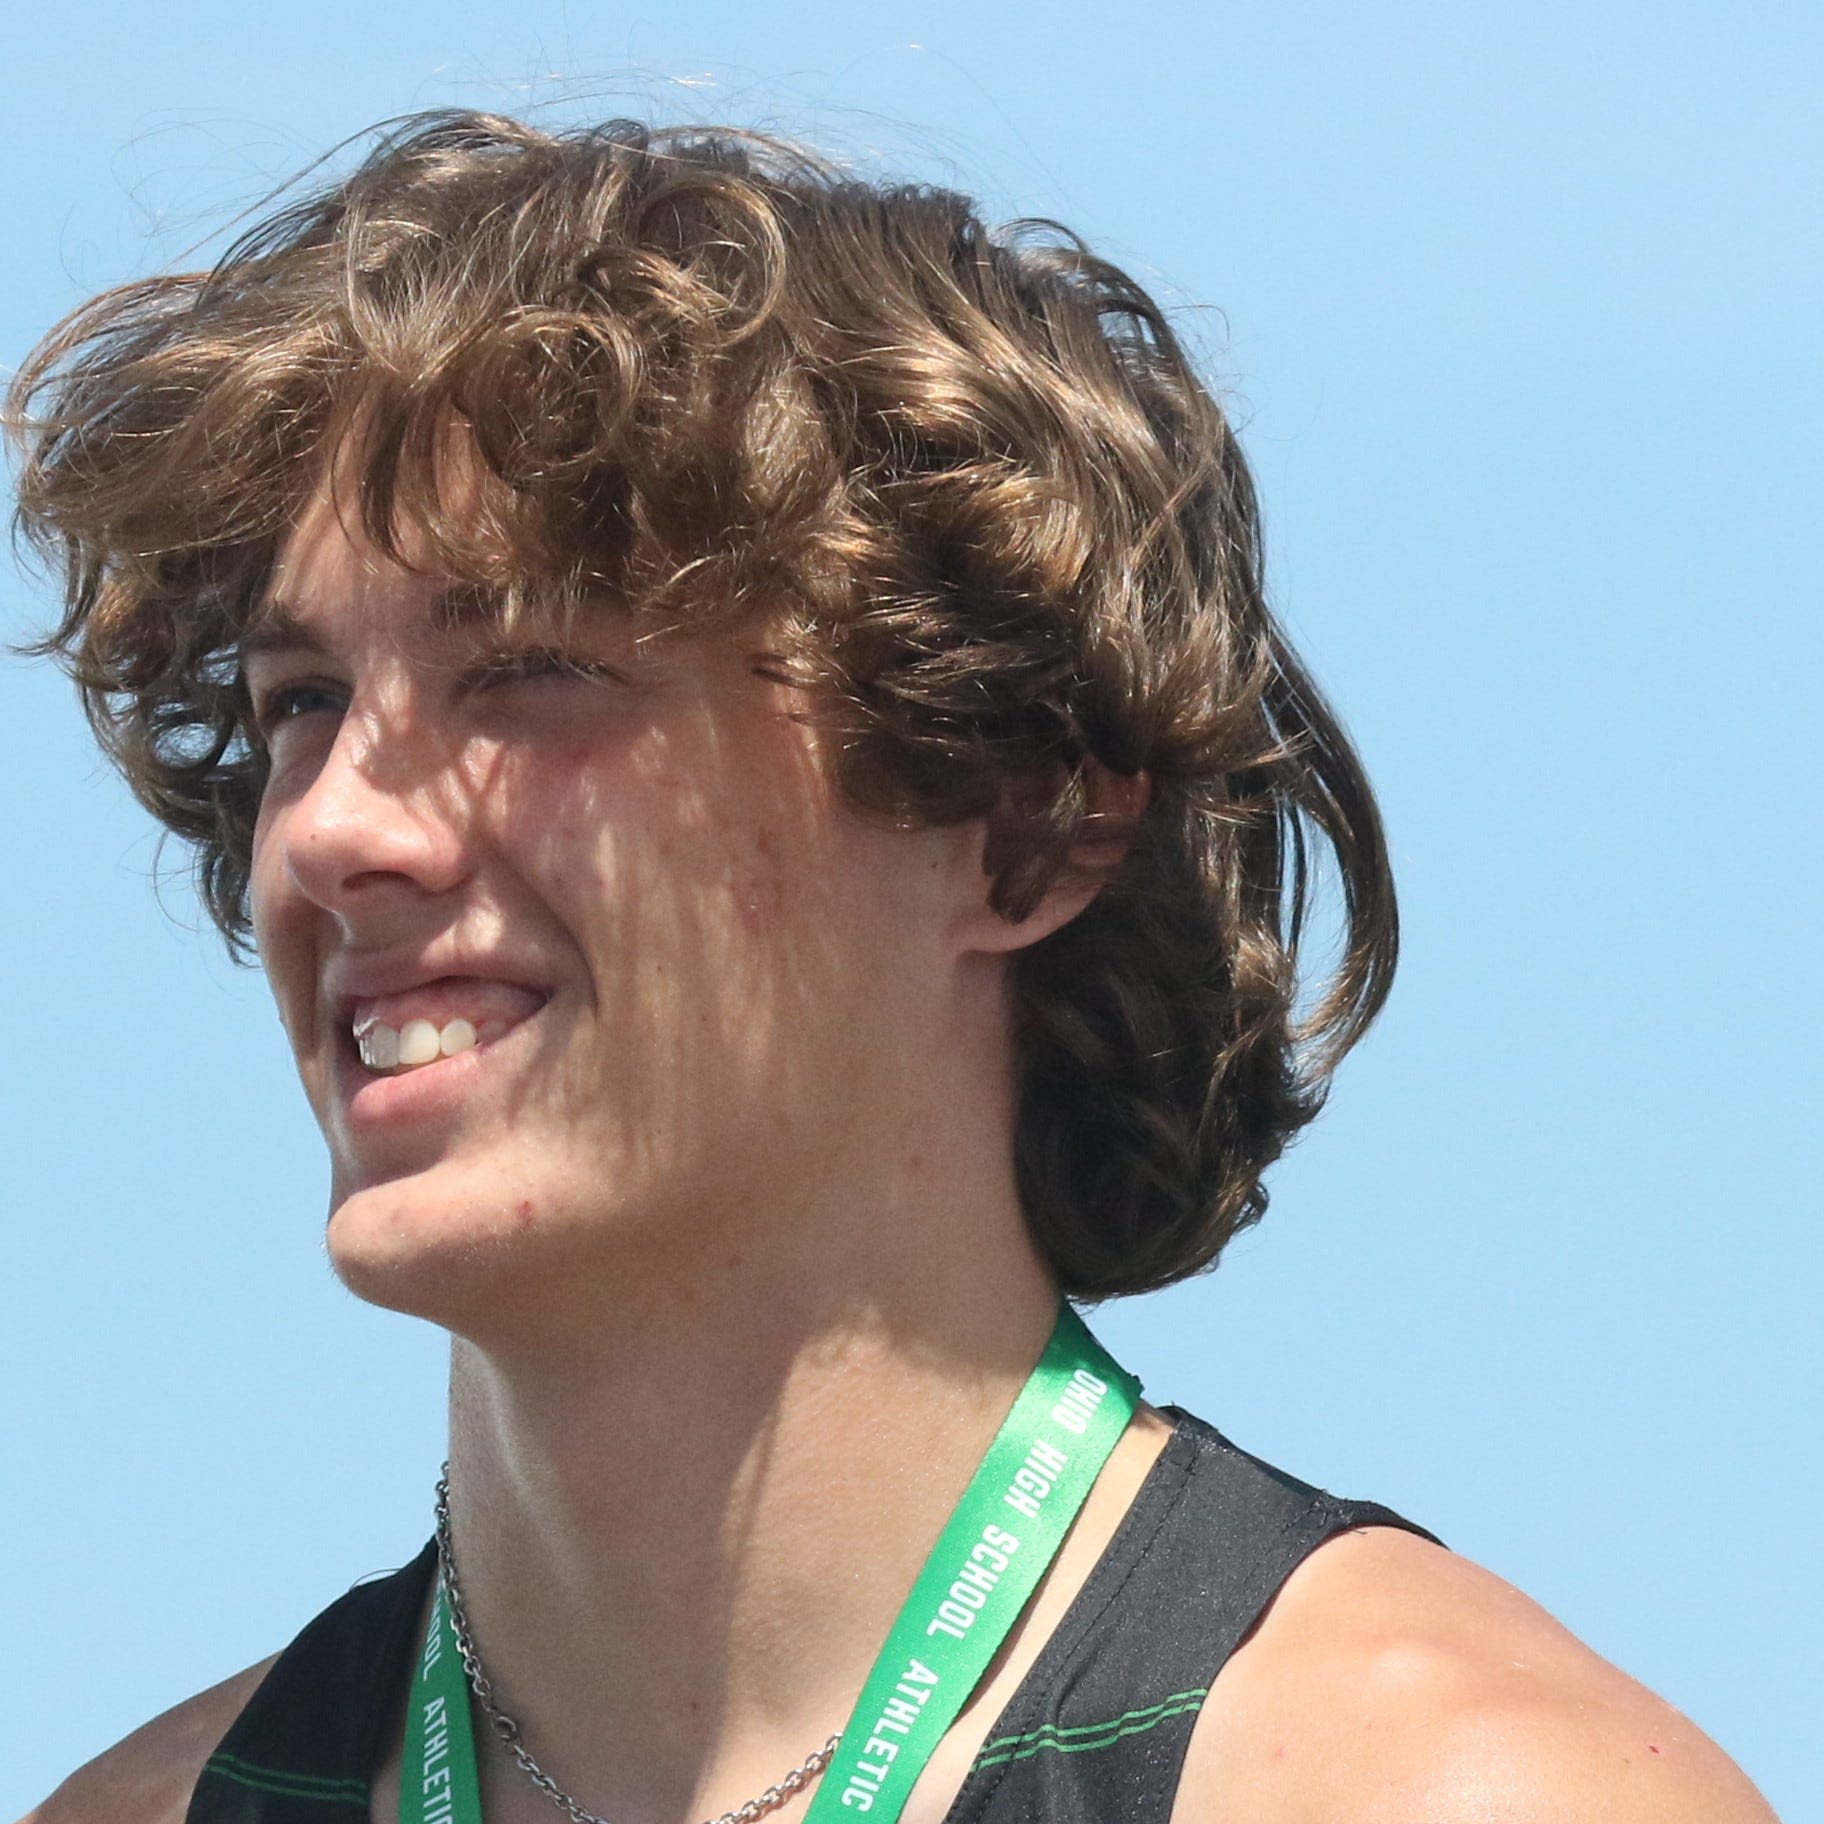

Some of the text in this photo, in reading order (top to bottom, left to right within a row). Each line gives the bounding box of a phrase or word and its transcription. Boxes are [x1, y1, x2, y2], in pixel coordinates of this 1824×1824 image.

[1048, 1367, 1108, 1437] OHIO
[1002, 1441, 1069, 1519] HIGH
[926, 1523, 1019, 1642] SCHOOL
[840, 1657, 942, 1814] ATHLETIC
